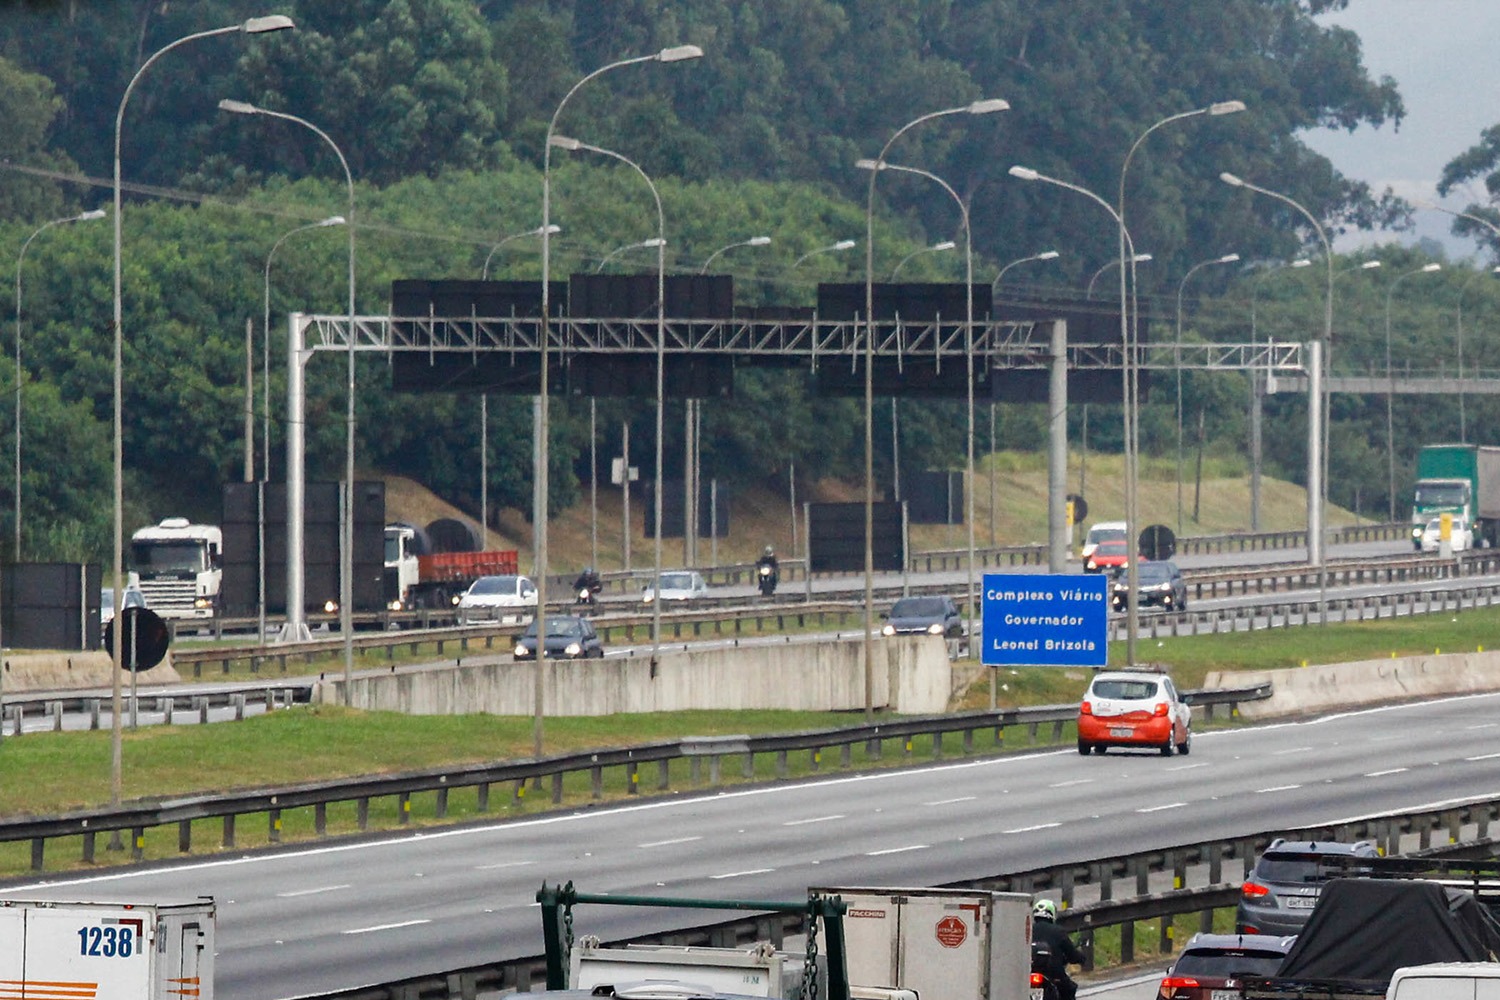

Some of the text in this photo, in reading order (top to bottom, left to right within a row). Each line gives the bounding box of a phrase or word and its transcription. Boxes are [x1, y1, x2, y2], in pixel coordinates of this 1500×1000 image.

[987, 587, 1103, 602] Complexo Viário
[1004, 614, 1084, 625] Governador
[993, 638, 1096, 651] Leonel Brizola
[78, 927, 132, 957] 1238
